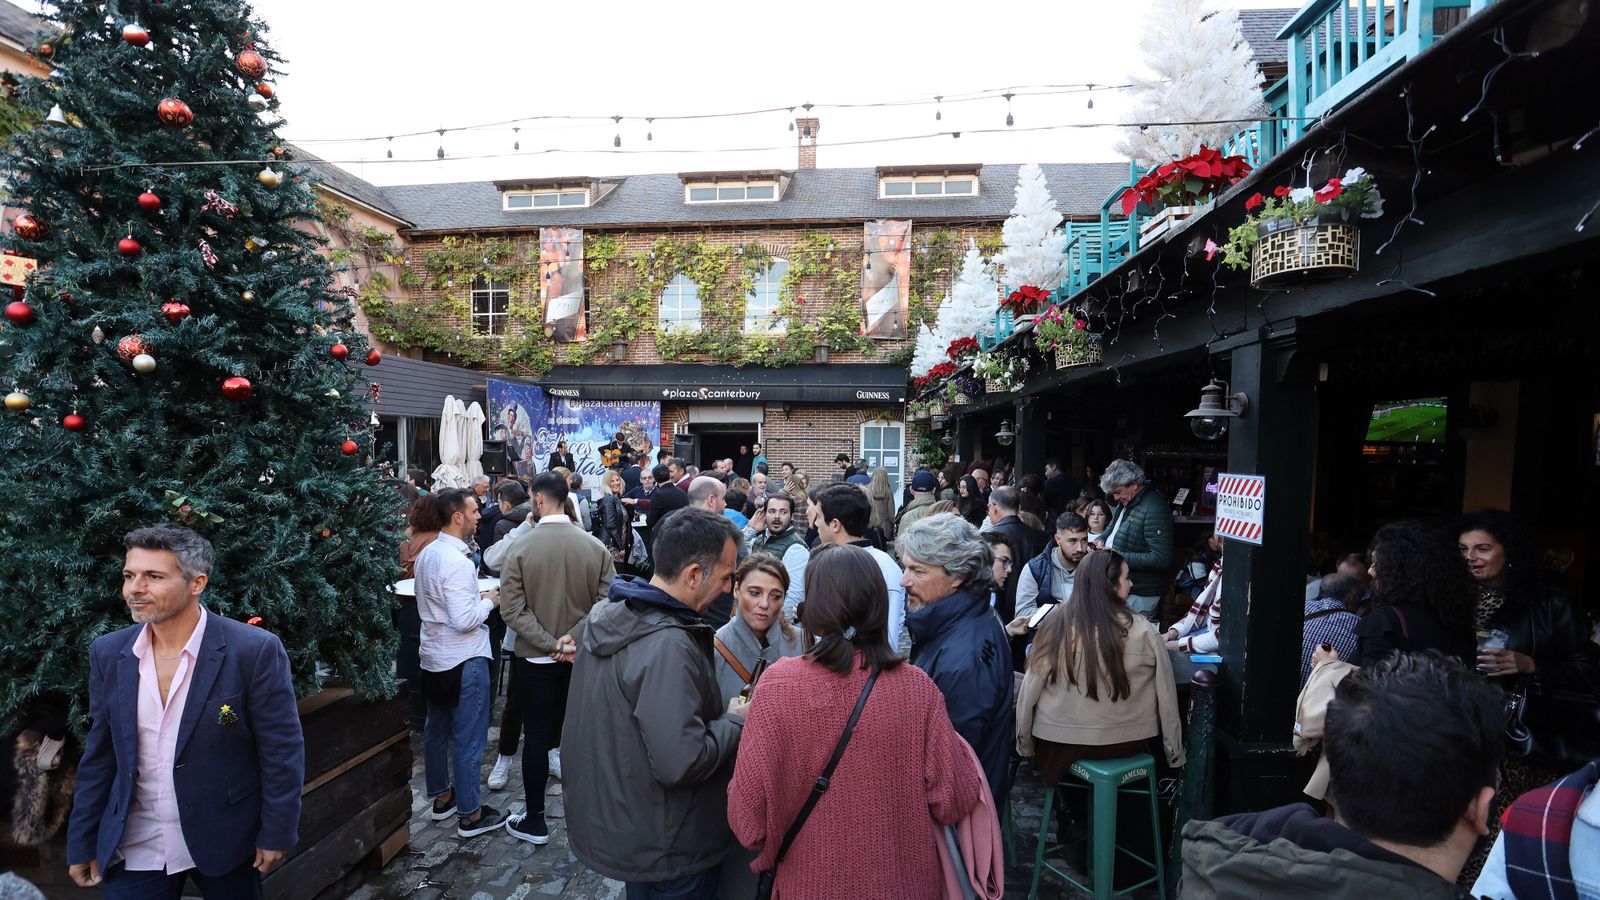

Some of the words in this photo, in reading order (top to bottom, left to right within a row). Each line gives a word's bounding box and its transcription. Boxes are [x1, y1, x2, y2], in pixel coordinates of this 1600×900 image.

[549, 388, 580, 397] GUINNESS
[856, 390, 890, 400] GUINNESS
[1218, 494, 1262, 511] PROHIBIDO
[1121, 768, 1148, 784] JAMESON
